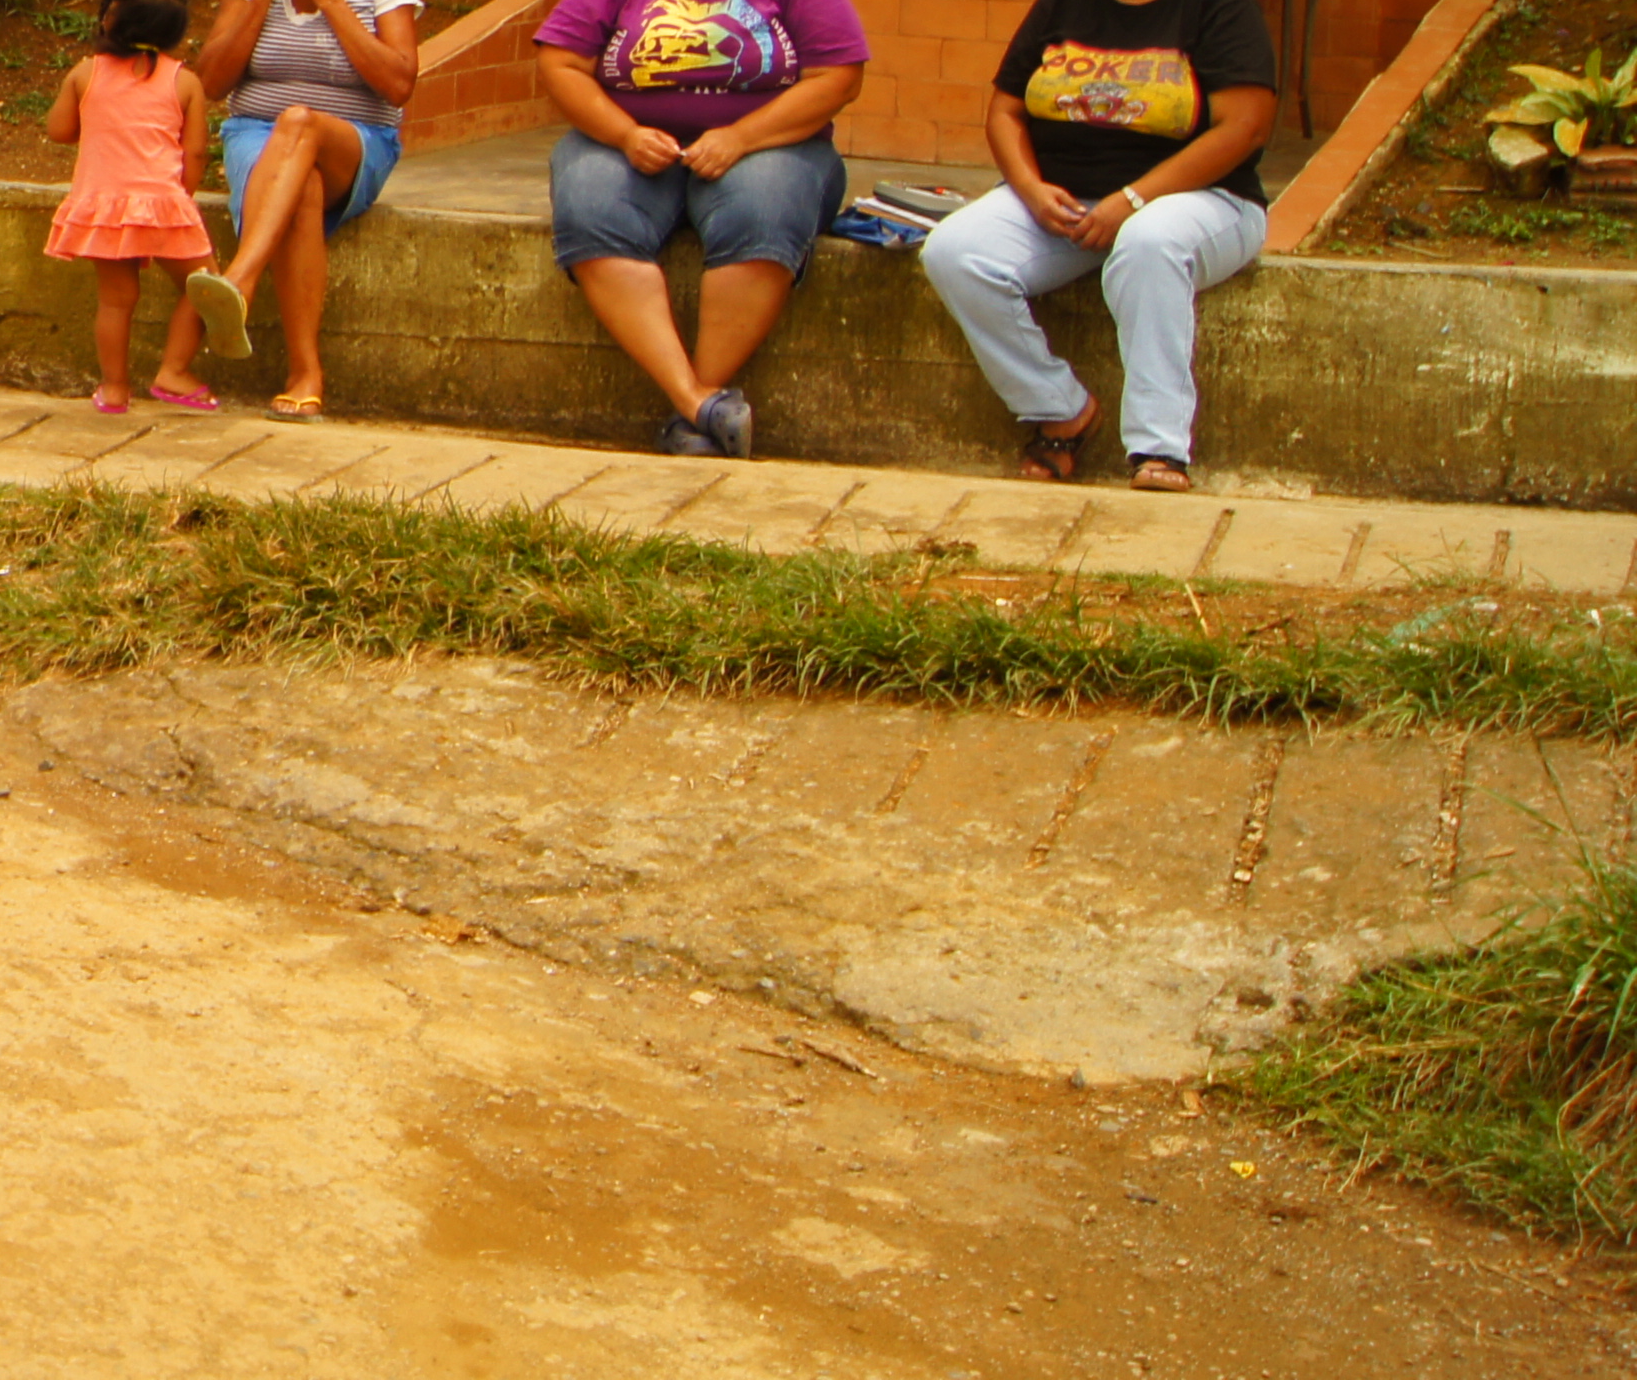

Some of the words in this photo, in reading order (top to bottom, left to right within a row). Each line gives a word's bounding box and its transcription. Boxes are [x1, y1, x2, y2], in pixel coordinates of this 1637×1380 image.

[603, 29, 628, 77] DIESEL
[771, 17, 798, 69] DIESEL
[1042, 53, 1184, 86] POKER
